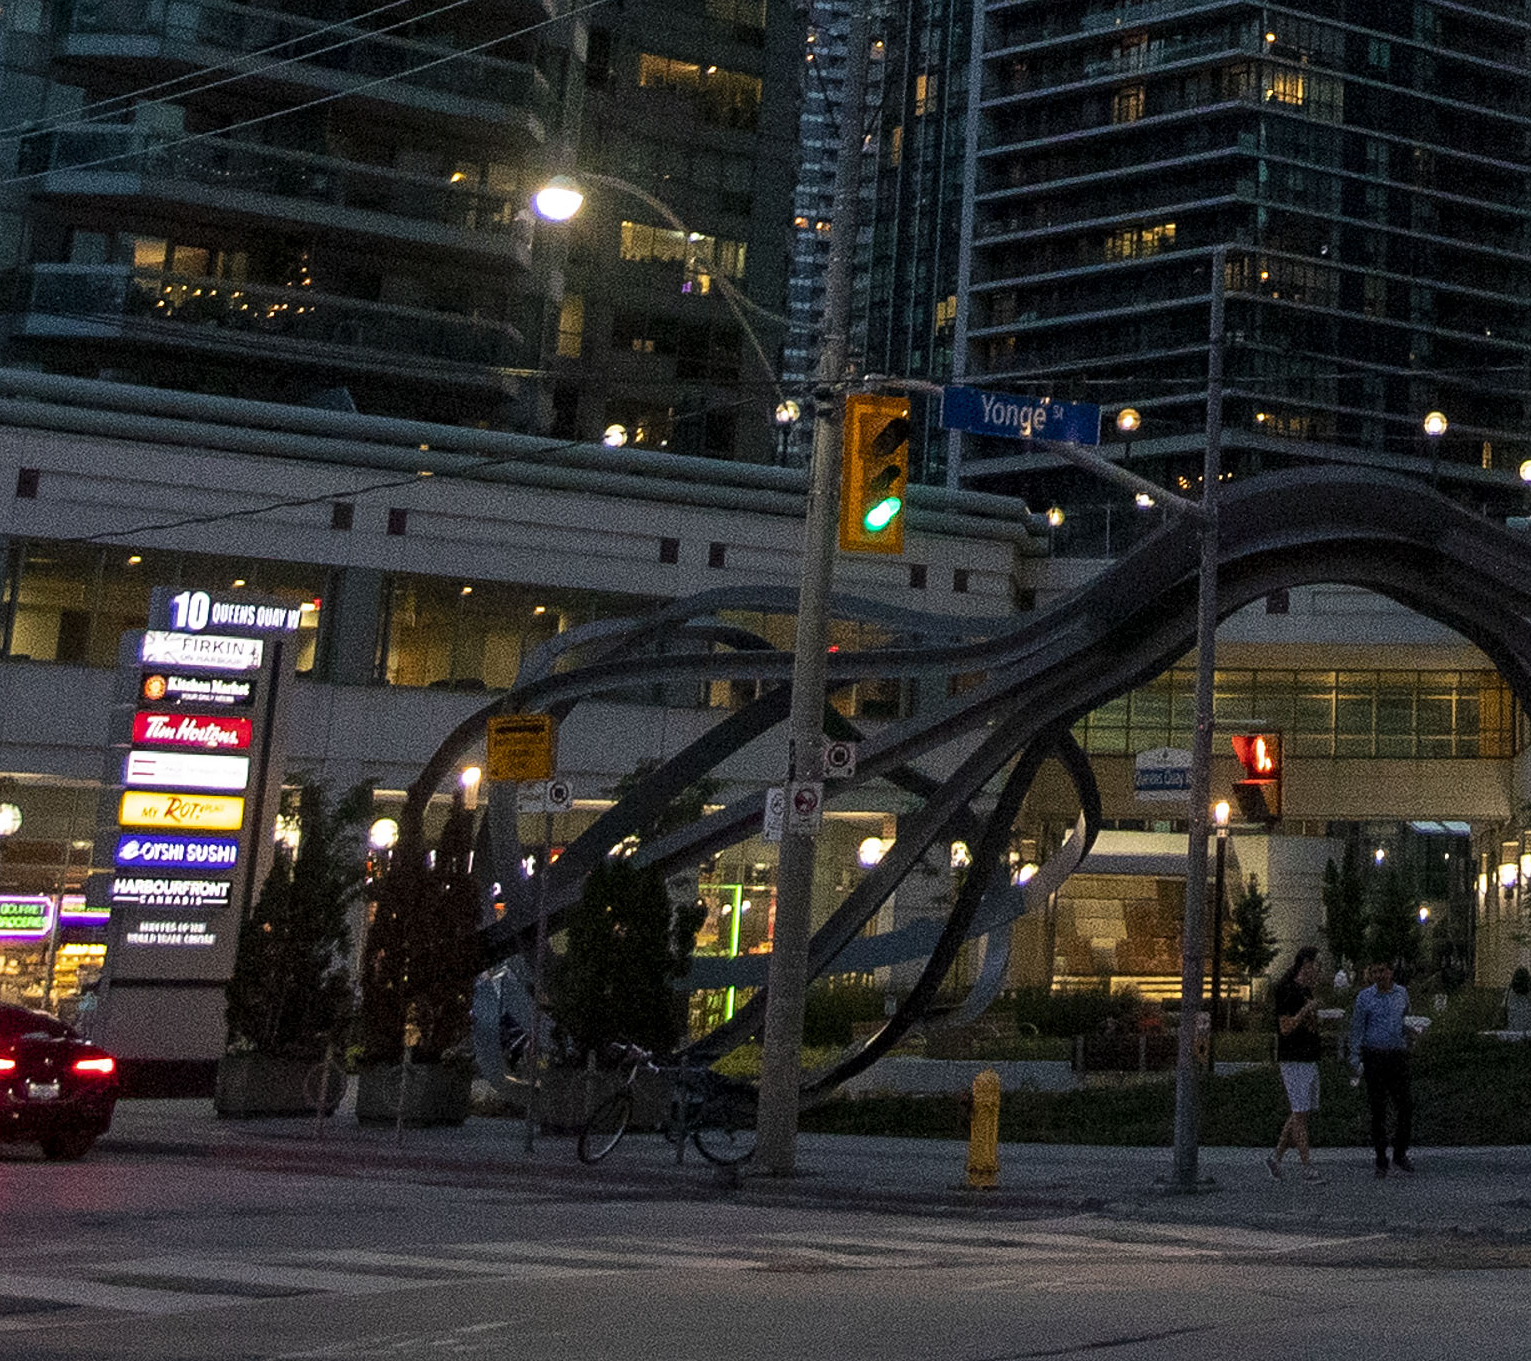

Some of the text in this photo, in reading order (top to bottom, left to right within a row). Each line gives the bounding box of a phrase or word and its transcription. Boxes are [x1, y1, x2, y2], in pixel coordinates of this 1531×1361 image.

[981, 394, 1064, 436] Yonge St
[173, 590, 211, 630] 10
[212, 602, 256, 626] QUEENS
[256, 605, 287, 628] QUAY
[181, 637, 246, 656] FIRKIN
[180, 654, 193, 663] ON
[167, 676, 250, 696] Kitchen Market
[145, 715, 175, 739] Tim
[141, 805, 159, 819] MY
[186, 843, 237, 863] SUSHI
[113, 878, 230, 897] HARBOURFRONT
[0, 903, 45, 915] GOURMET
[139, 895, 203, 906] CANNABIS
